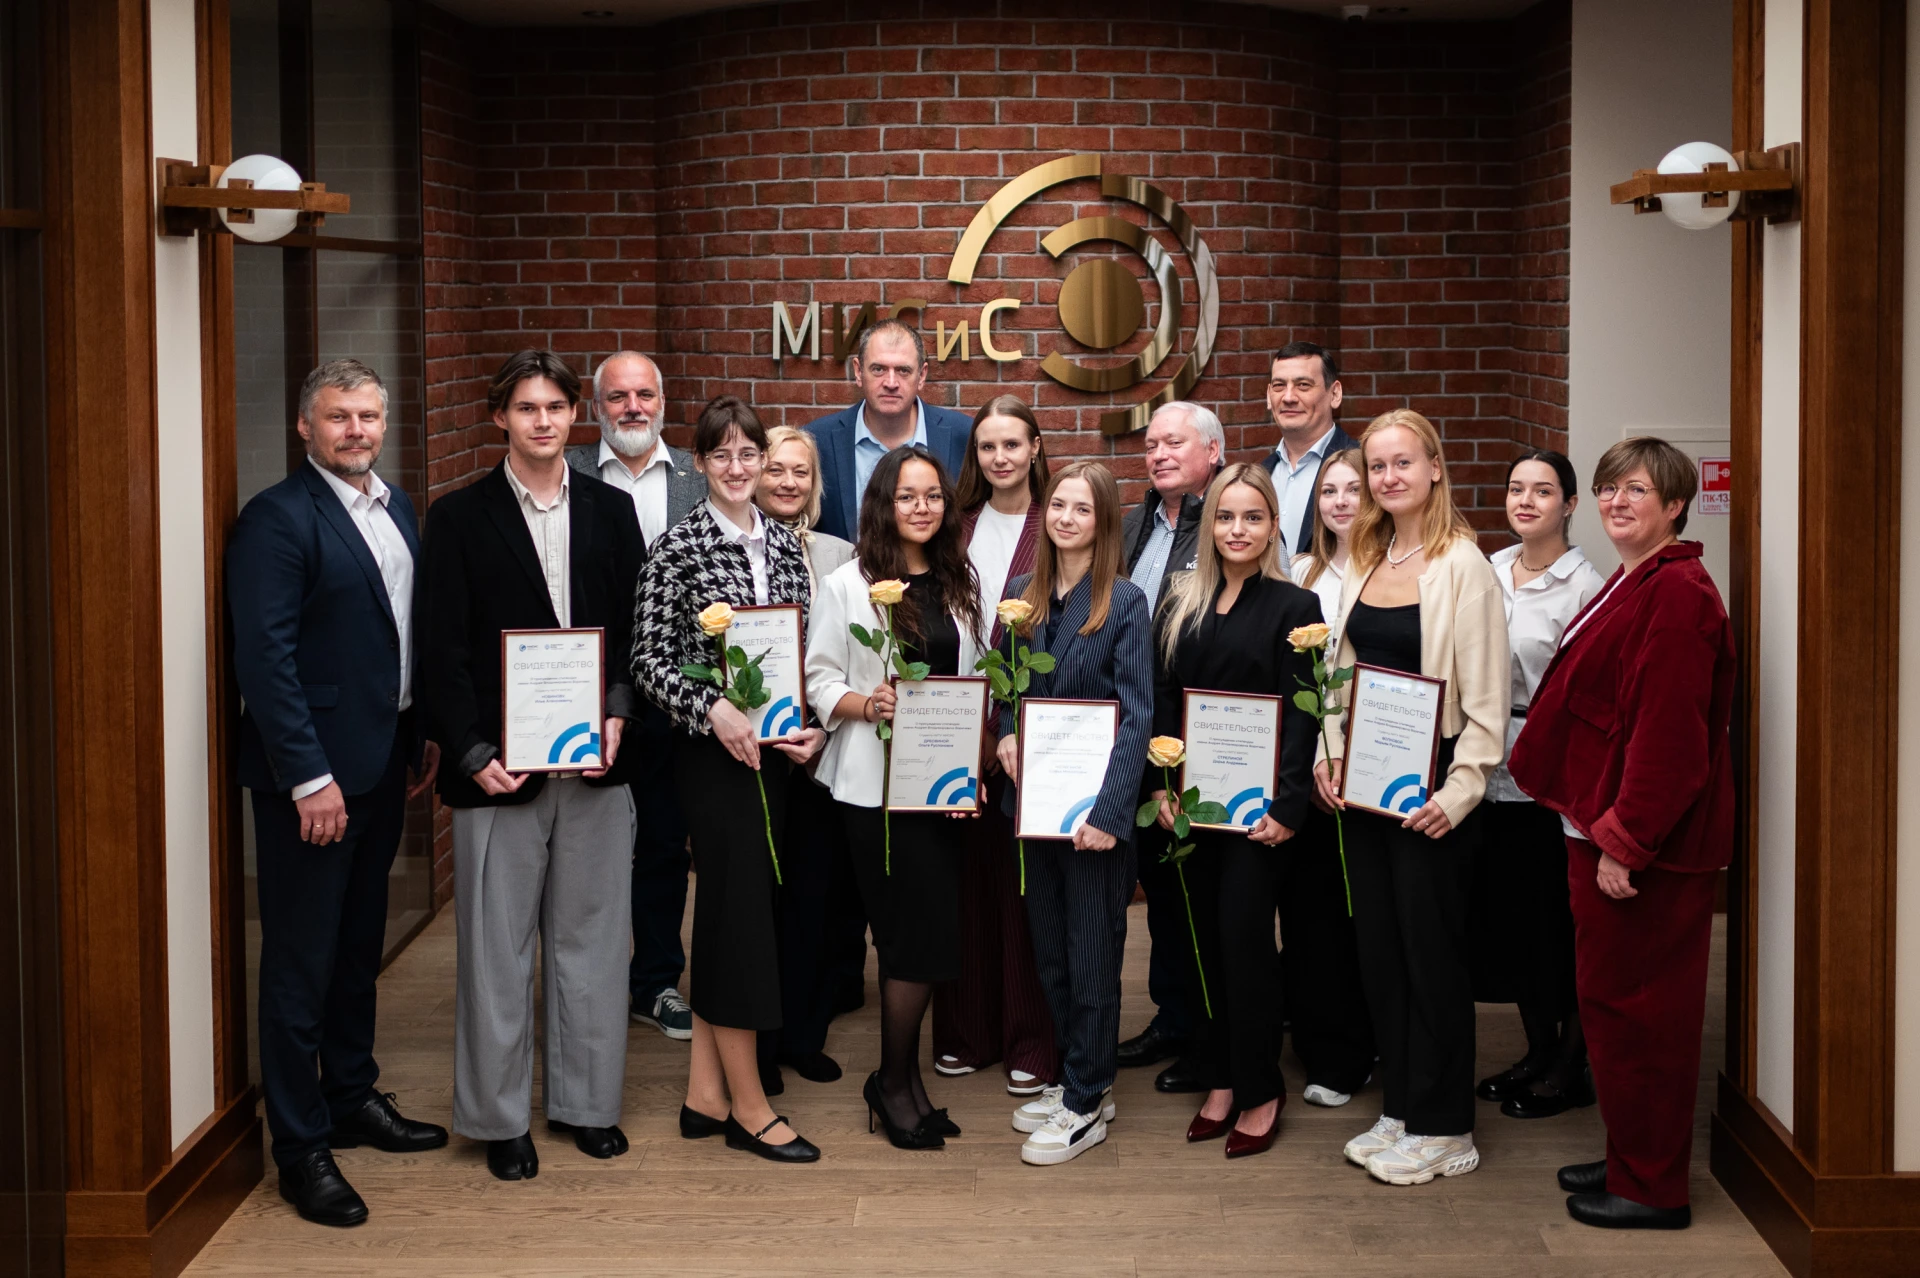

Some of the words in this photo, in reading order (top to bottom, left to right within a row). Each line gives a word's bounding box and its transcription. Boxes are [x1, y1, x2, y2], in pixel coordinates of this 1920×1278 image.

[1702, 493, 1730, 503] ПК-13
[730, 636, 794, 647] СВИДЕТЕЛЬСТВО
[513, 660, 594, 670] СВИДЕТЕЛЬСТВО
[900, 707, 977, 716] СВИДЕТЕЛЬСТВО
[1362, 698, 1432, 720] СВИДЕТЕЛЬСТВО
[1193, 721, 1271, 734] СВИДЕТЕЛЬСТВО
[1031, 732, 1109, 741] СВИДЕТЕЛЬСТВО
